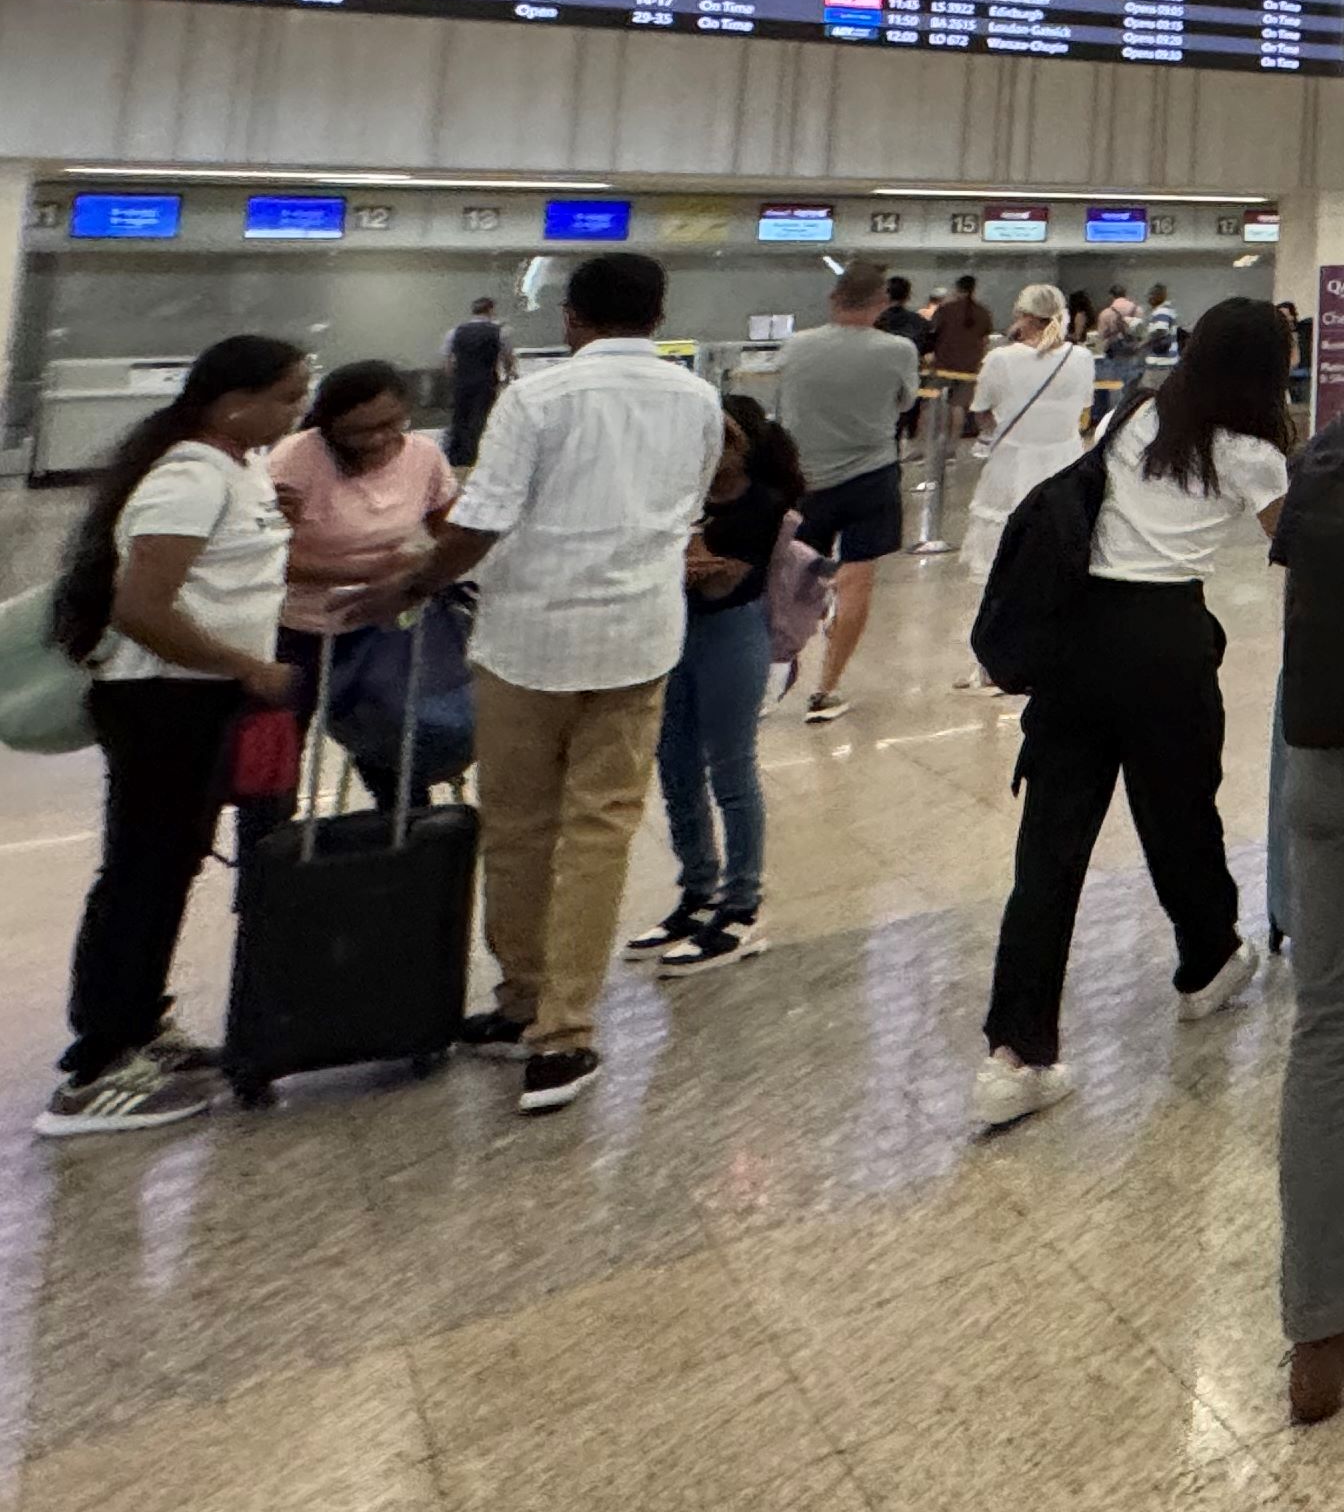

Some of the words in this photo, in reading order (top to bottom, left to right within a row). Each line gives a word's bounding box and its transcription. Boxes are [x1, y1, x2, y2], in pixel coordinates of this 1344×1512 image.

[698, 0, 721, 12] On
[722, 1, 755, 15] Time
[515, 4, 558, 19] Open
[632, 11, 674, 26] 29-35
[697, 16, 720, 29] On
[721, 18, 754, 32] Time
[358, 208, 389, 228] 12
[873, 214, 898, 233] 14
[954, 215, 977, 233] 15
